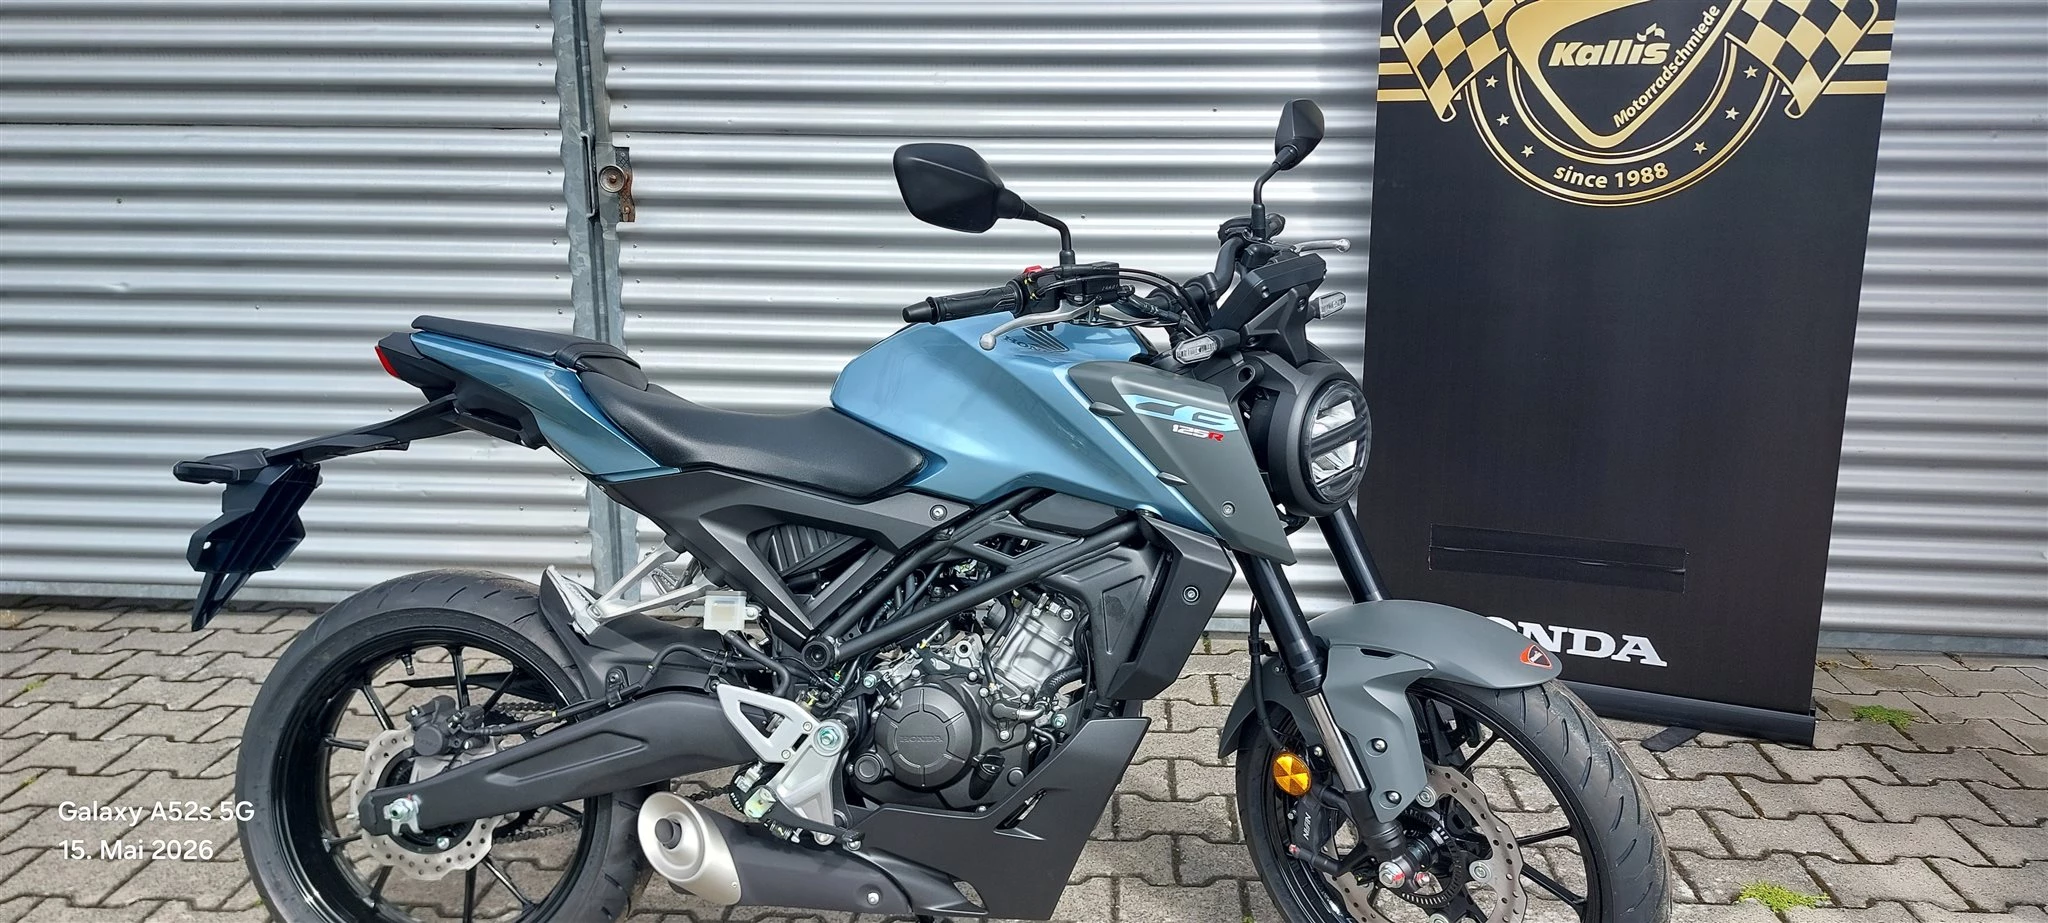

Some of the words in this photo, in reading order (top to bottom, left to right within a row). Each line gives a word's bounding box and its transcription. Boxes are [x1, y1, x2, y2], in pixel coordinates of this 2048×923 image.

[1612, 5, 1720, 128] Motorradschmiede
[1553, 165, 1608, 188] since
[1614, 162, 1669, 188] 1988
[1172, 424, 1225, 442] 125R
[1486, 616, 1668, 668] NDA
